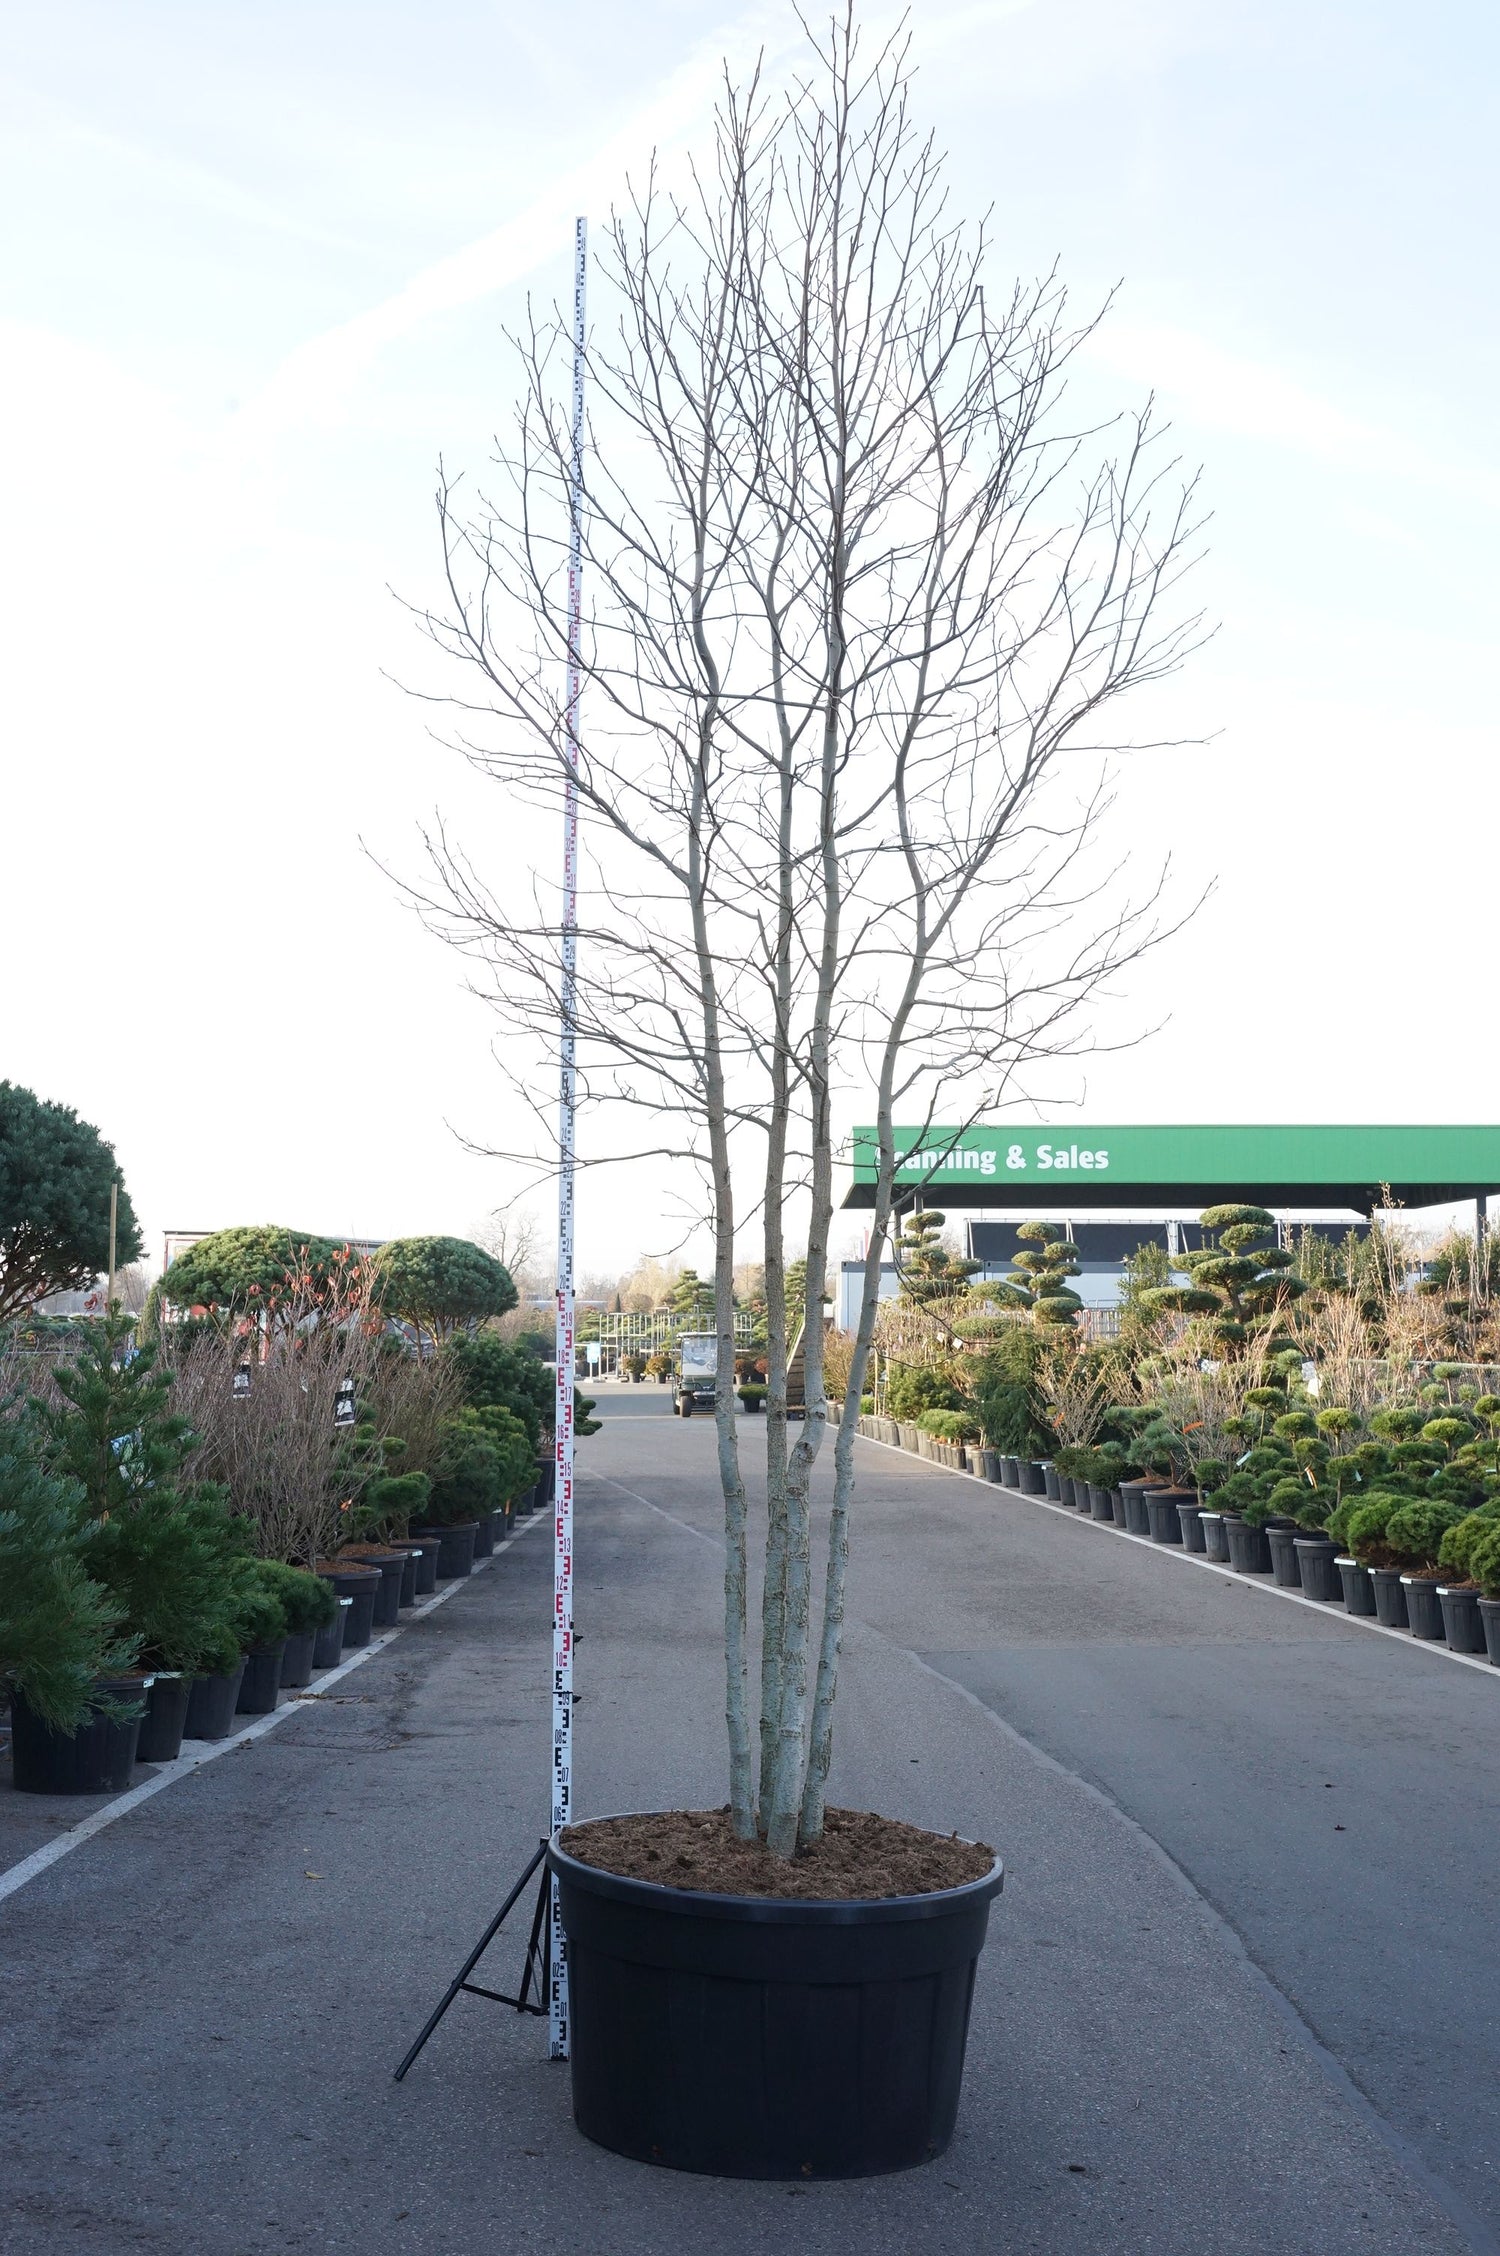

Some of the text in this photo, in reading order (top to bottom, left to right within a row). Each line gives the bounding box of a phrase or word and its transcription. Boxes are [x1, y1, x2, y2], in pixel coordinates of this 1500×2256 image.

[1006, 1145, 1027, 1169] &
[1037, 1145, 1109, 1169] Sales
[560, 1200, 567, 1216] 22
[566, 1238, 573, 1253] 21
[565, 1312, 573, 1327] 19
[558, 1349, 565, 1365] 18
[565, 1386, 572, 1401] 17
[557, 1424, 564, 1439] 16
[564, 1462, 571, 1477] 15
[556, 1500, 564, 1515] 14
[564, 1538, 570, 1552] 13
[556, 1575, 564, 1590] 12
[563, 1613, 571, 1629] 11
[556, 1651, 563, 1667] 10
[554, 1729, 562, 1744] 08
[561, 1767, 569, 1783] 07
[553, 1806, 561, 1821] 06
[552, 1962, 560, 1978] 02
[560, 2001, 567, 2017] 01
